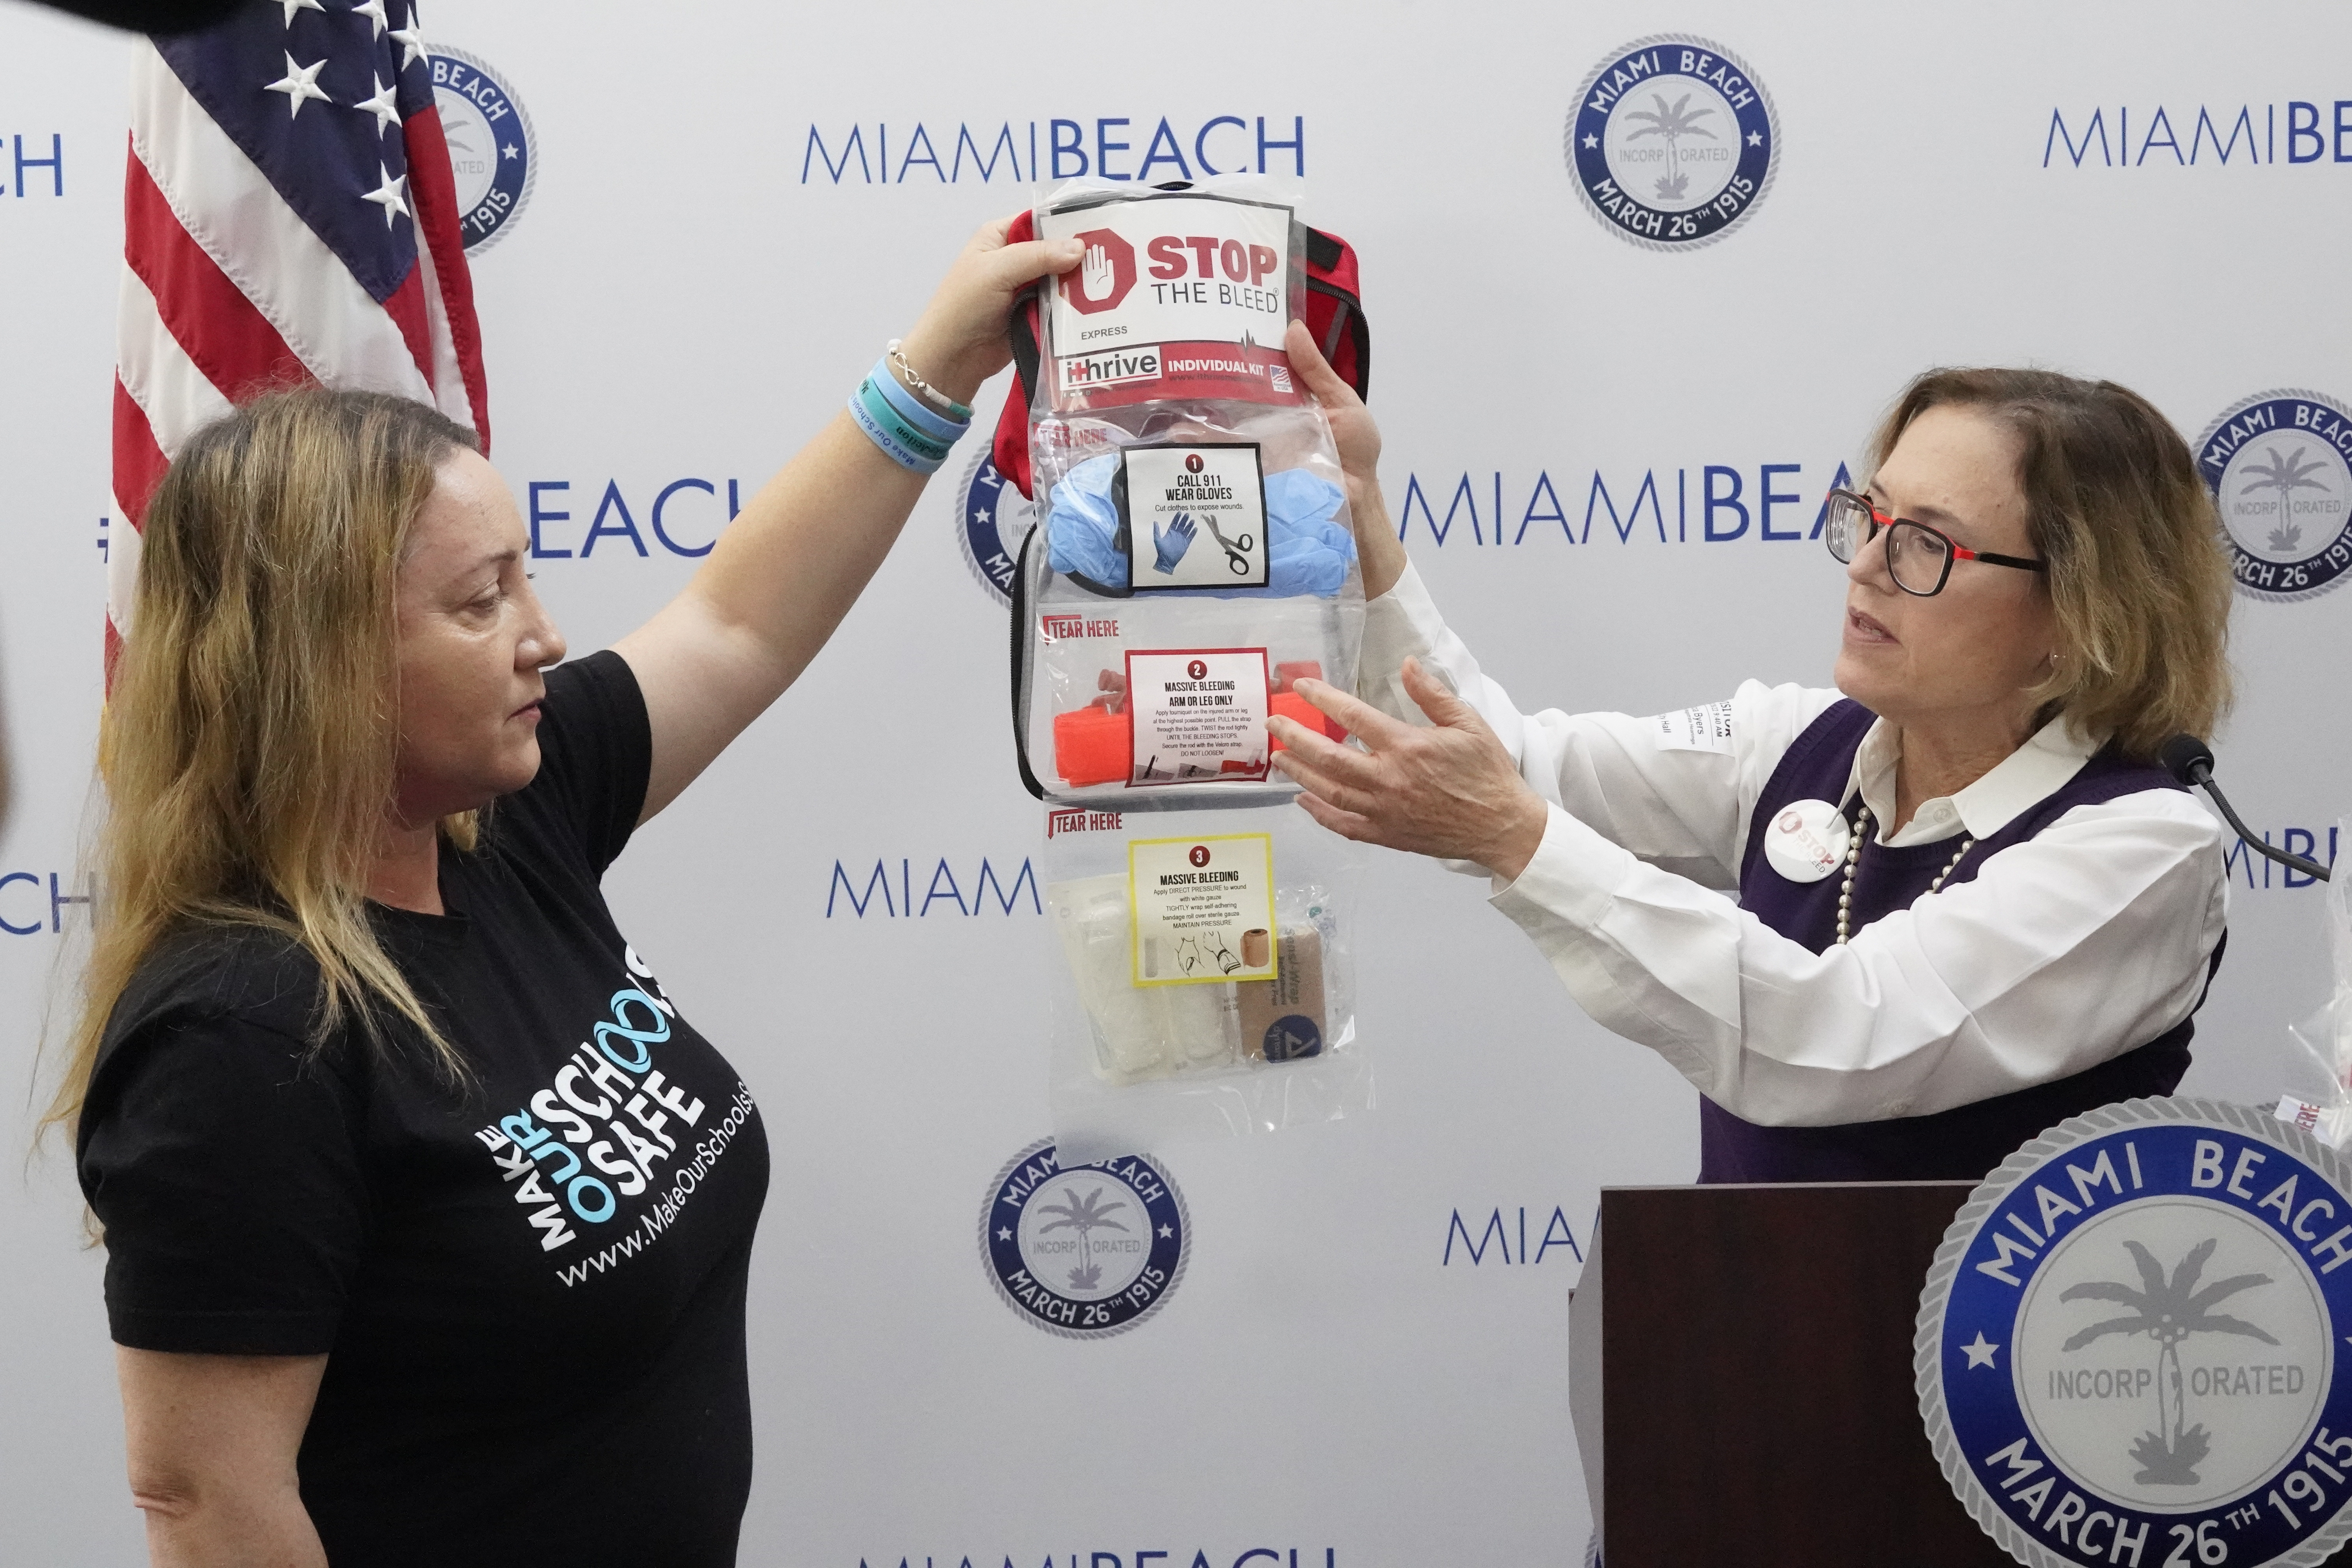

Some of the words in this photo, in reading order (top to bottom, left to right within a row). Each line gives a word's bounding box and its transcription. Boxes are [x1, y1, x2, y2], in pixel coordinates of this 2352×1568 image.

[434, 61, 508, 122] BEACH
[1589, 51, 1661, 113] MIAMI
[1680, 50, 1754, 109] BEACH
[802, 115, 1304, 184] MIAMIBEACH
[1619, 149, 1664, 163] INCORP
[1680, 147, 1728, 161] ORATED
[470, 188, 510, 233] 1915
[1593, 178, 1663, 236] MARCH
[1713, 175, 1753, 219] 1915
[1147, 235, 1277, 287] STOP
[1151, 283, 1206, 305] THE
[1081, 326, 1128, 340] EXPRESS
[1168, 359, 1247, 373] INDIVIDUAL
[1249, 363, 1264, 376] KIT
[852, 397, 875, 430] Schools
[875, 430, 891, 446] Our
[1074, 428, 1107, 447] HERE
[2204, 406, 2276, 467] MIAMI
[892, 445, 916, 465] Make
[1191, 458, 1198, 469] 1
[1178, 475, 1201, 487] CALL
[1204, 475, 1221, 486] 911
[1166, 488, 1194, 501] WEAR
[1197, 488, 1232, 499] GLOVES
[2294, 500, 2340, 513] ORATED
[1051, 621, 1083, 638] TEAR
[1087, 620, 1119, 637] HERE
[1194, 664, 1200, 675] 2
[1165, 682, 1197, 691] MASSIVE
[1200, 681, 1234, 691] BLEEDING
[1170, 697, 1185, 706] ARM
[1188, 697, 1197, 706] OR
[1200, 696, 1212, 706] LEG
[1215, 695, 1232, 705] ONLY
[1661, 721, 1671, 733] Hall
[1693, 713, 1704, 735] Byers
[1716, 726, 1722, 737] AM
[1056, 815, 1086, 833] TEAR
[1091, 813, 1122, 831] HERE
[1196, 850, 1202, 863] 3
[1798, 829, 1835, 864] STOP
[1160, 873, 1196, 885] MASSIVE
[1199, 871, 1239, 883] BLEEDING
[588, 1070, 705, 1196] SAFE
[500, 1109, 616, 1223] OUR
[475, 1125, 576, 1252] MAKE
[1976, 1141, 2143, 1287] MIAMI
[2191, 1139, 2352, 1276] BEACH
[1033, 1240, 1076, 1254] INCORP
[1093, 1240, 1140, 1254] ORATED
[1008, 1269, 1076, 1323] MARCH
[1126, 1265, 1164, 1308] 1915
[2048, 1368, 2152, 1400] INCORP
[2191, 1365, 2304, 1396] ORATED
[1985, 1437, 2151, 1568] MARCH
